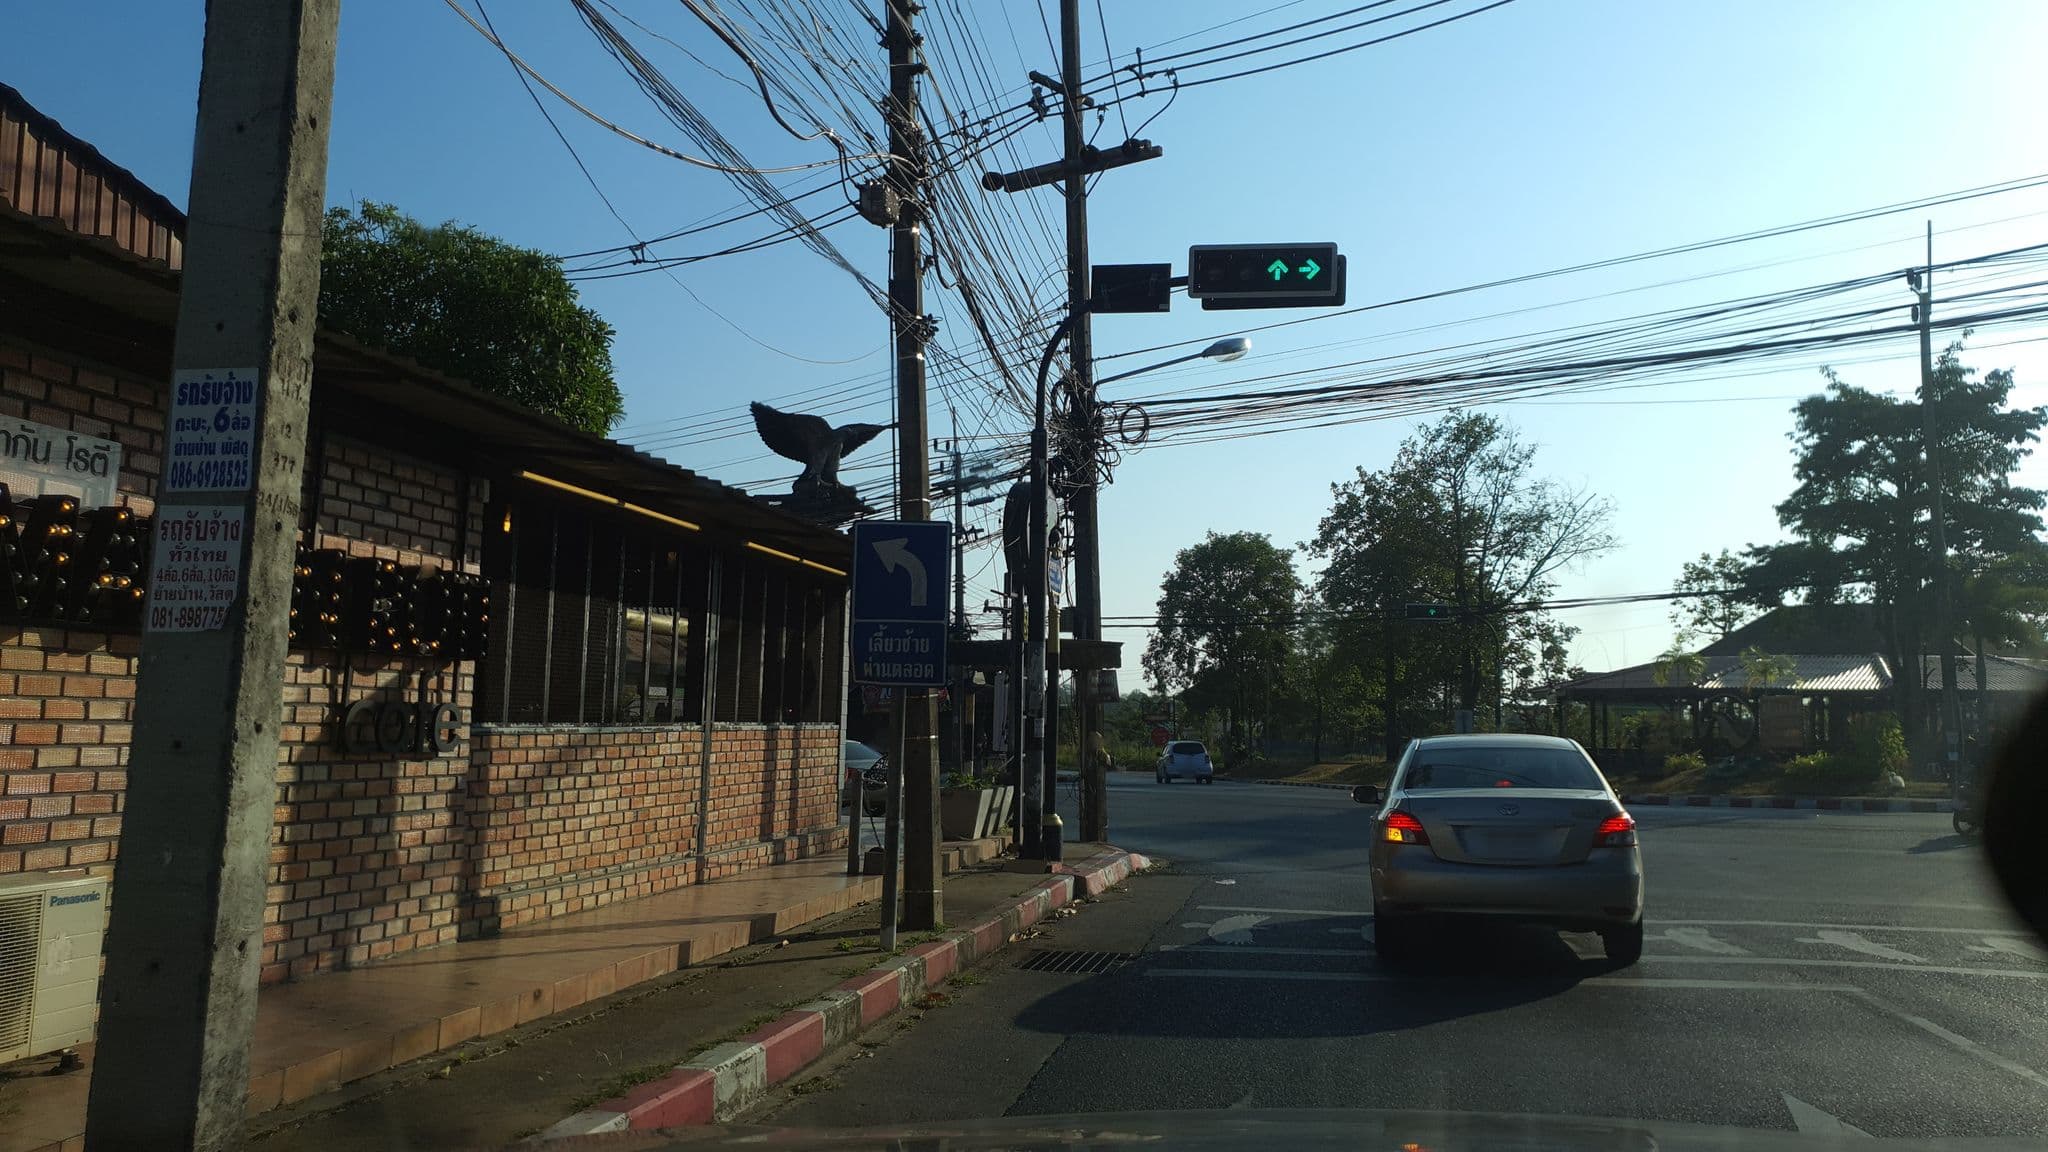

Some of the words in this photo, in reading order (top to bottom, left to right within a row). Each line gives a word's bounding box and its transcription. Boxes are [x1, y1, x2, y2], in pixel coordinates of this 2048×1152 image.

[177, 371, 253, 405] รถรับจ้าง
[66, 435, 111, 478] โรตี
[171, 460, 248, 488] 086-6928525
[160, 510, 241, 541] รถรับจ้าง
[168, 542, 228, 562] ทั่วไทย
[868, 624, 930, 653] เลี้ยวซ้าย
[863, 656, 934, 679] ผ่านตลอด
[49, 891, 101, 907] Panasonic
